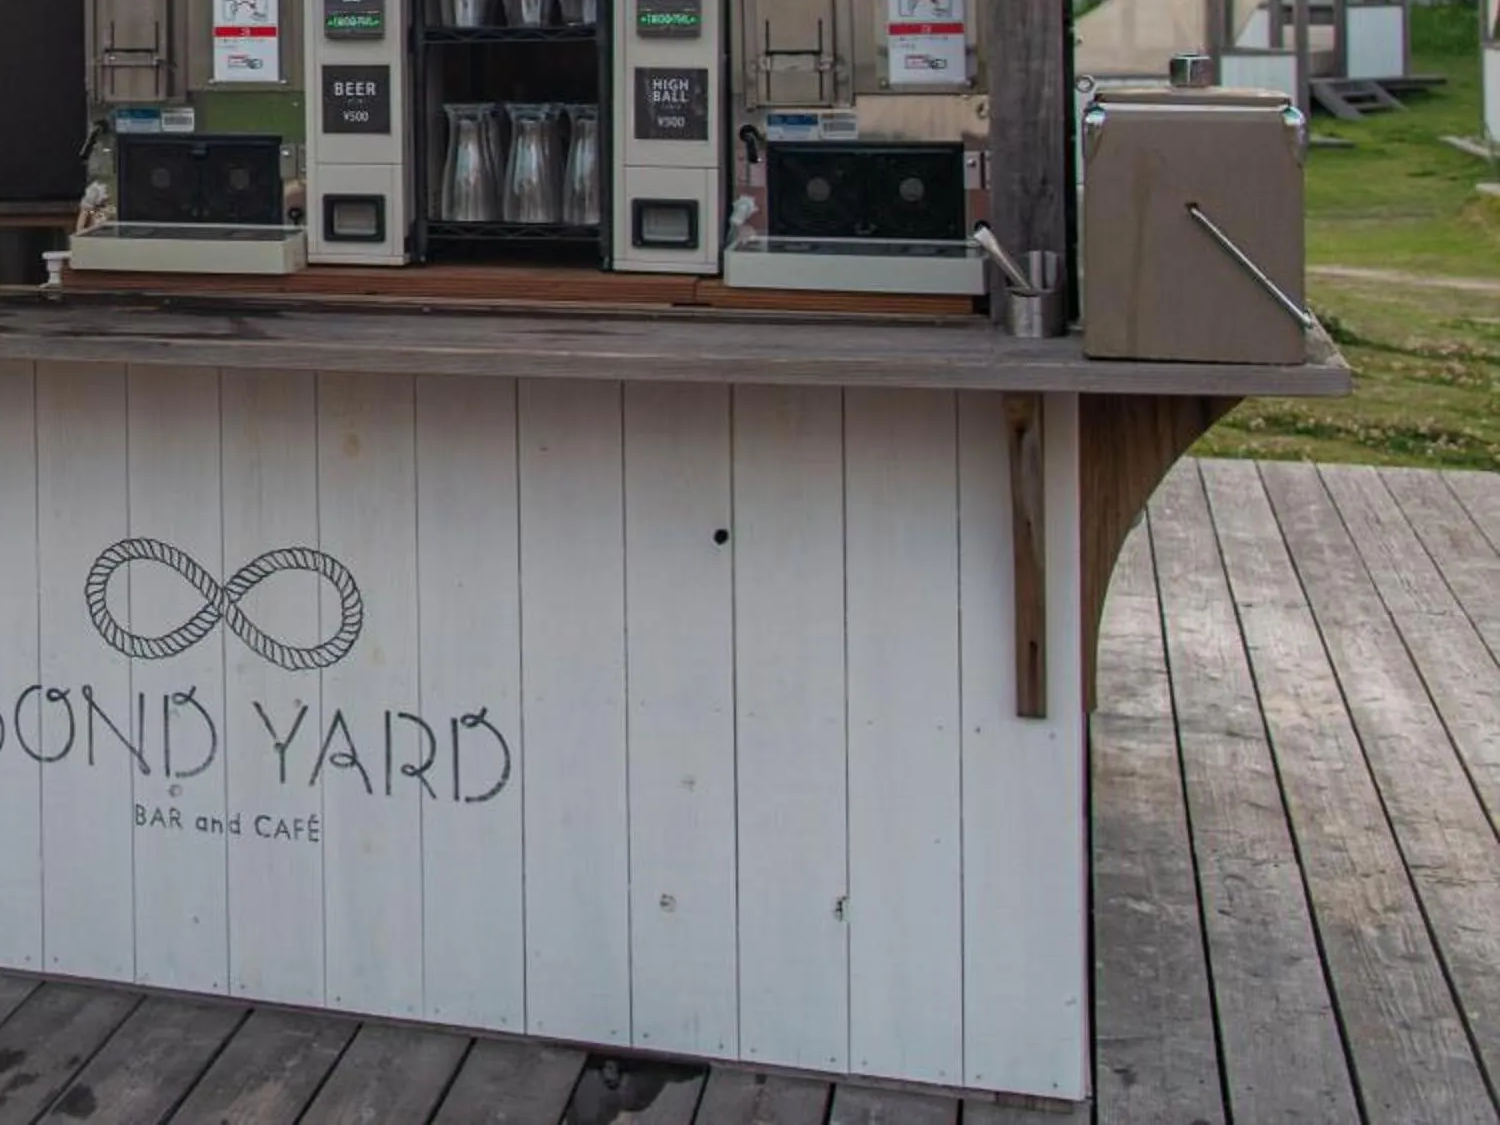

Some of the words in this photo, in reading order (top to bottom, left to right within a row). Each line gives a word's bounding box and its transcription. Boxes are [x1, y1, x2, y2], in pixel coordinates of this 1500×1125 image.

[333, 81, 376, 96] BEER
[652, 78, 689, 91] HIGH
[652, 90, 689, 103] BALL
[343, 110, 369, 122] ¥500
[253, 701, 511, 803] YARD
[134, 803, 183, 829] BAR
[195, 812, 242, 835] and
[253, 813, 320, 843] CAFÉ
